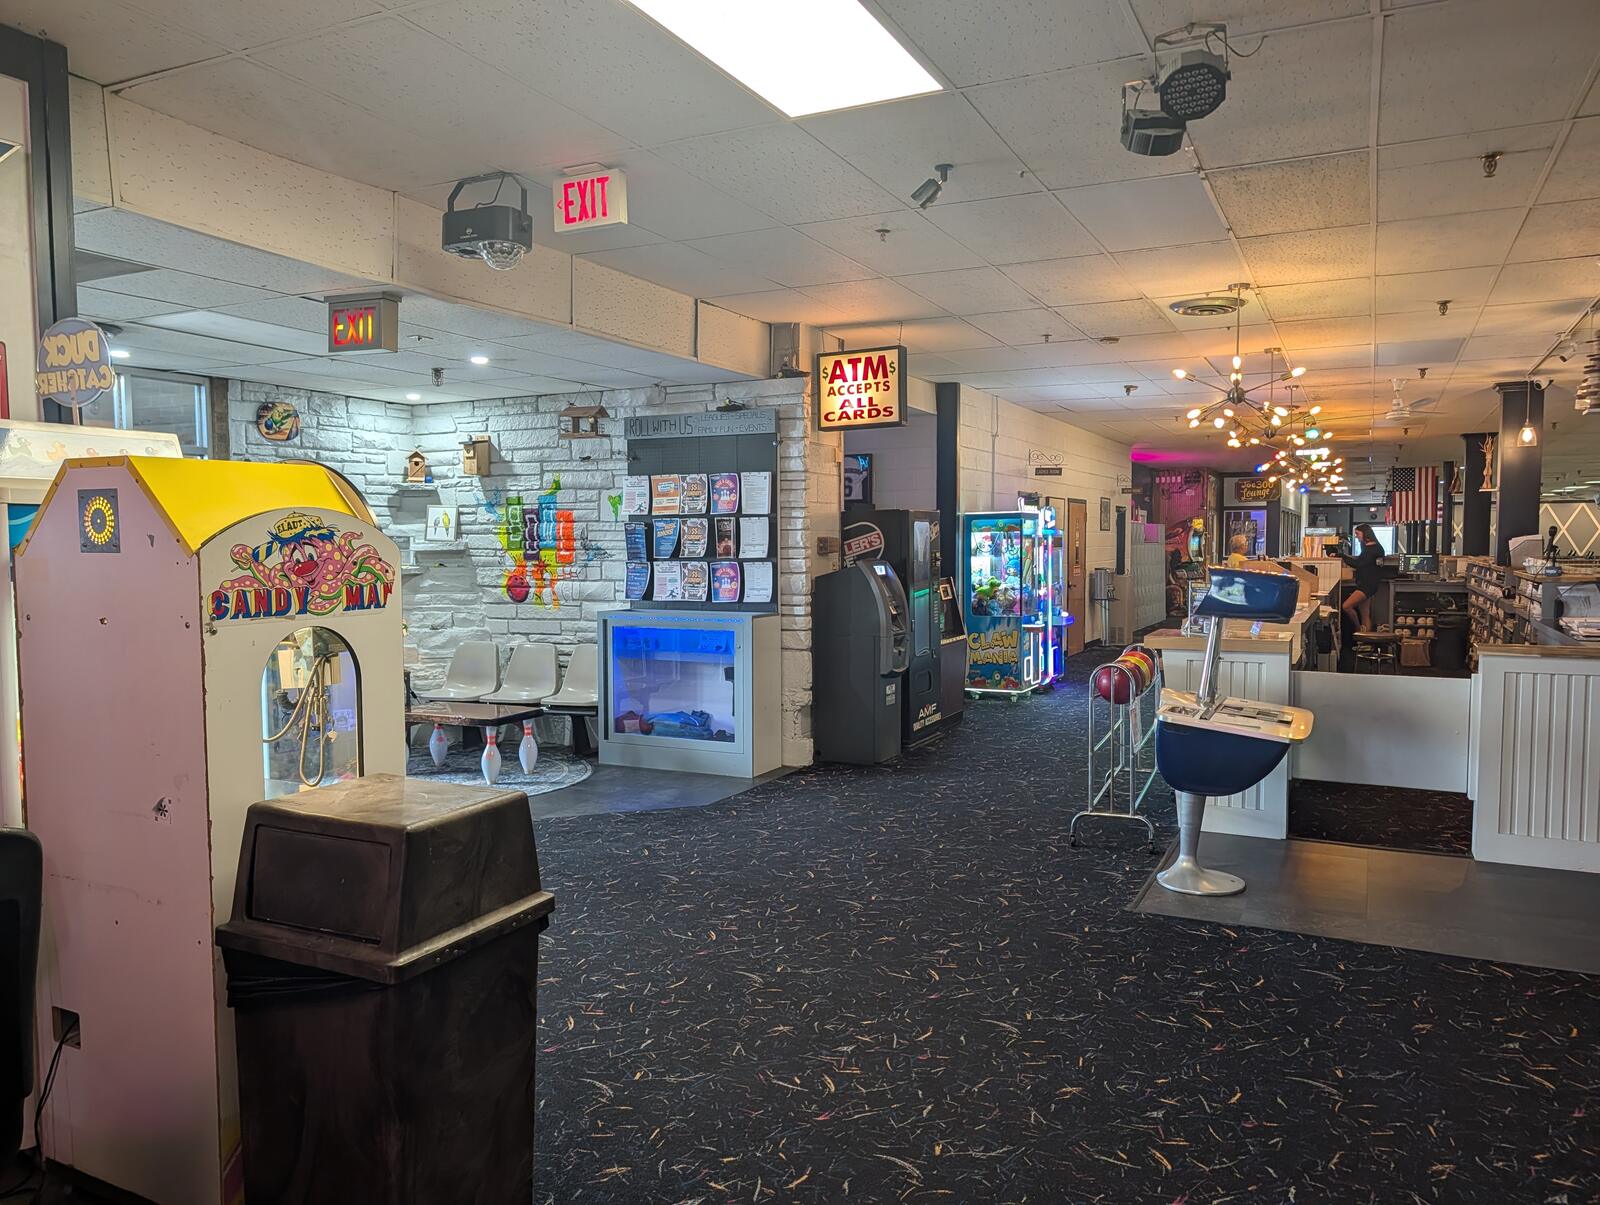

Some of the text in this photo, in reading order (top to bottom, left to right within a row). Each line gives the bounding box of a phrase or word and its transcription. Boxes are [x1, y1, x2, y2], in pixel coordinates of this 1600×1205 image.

[563, 176, 609, 224] EXIT
[332, 306, 376, 346] EXIT
[828, 355, 889, 384] ATM
[827, 381, 891, 397] ACCEPTS
[839, 396, 878, 410] ALL
[823, 406, 894, 422] CARDS
[629, 415, 694, 437] ROLL WITH US
[207, 586, 310, 621] CANDY
[968, 630, 1018, 650] CLAW
[969, 650, 1018, 665] MANIA
[918, 703, 937, 719] AMF
